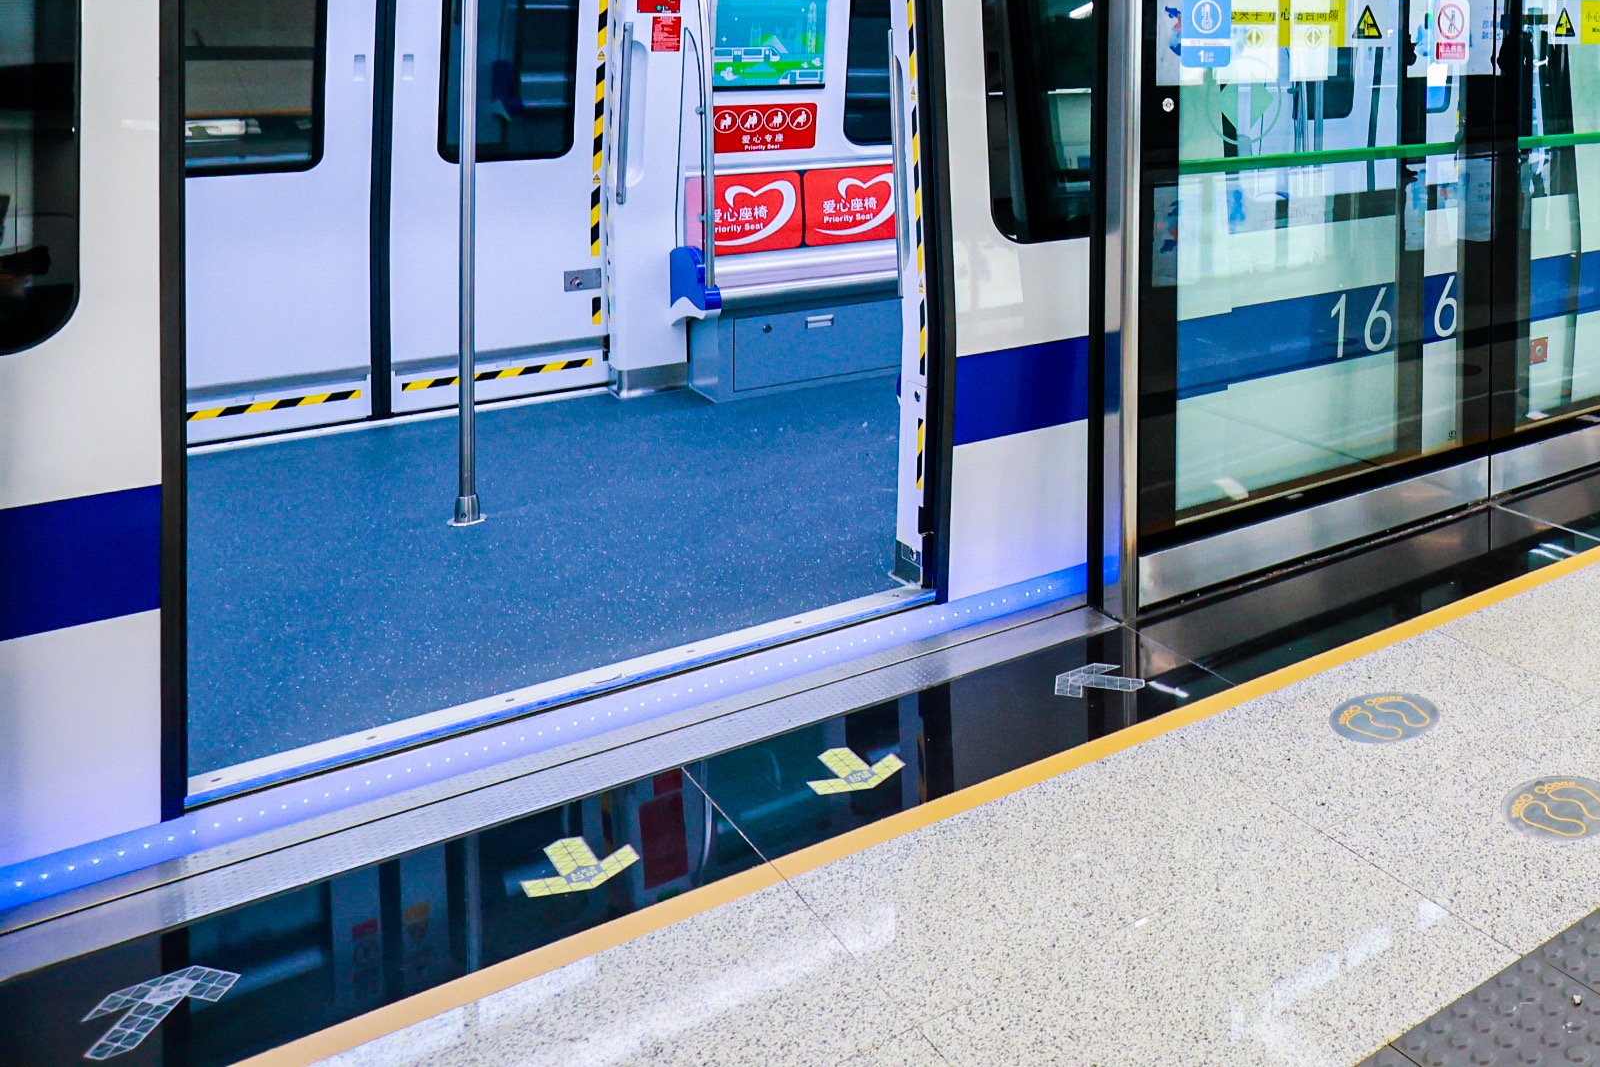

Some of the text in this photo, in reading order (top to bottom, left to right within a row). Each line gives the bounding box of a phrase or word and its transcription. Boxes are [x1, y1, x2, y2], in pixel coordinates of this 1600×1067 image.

[741, 133, 784, 144] 爱心专座
[822, 196, 877, 214] 爱心座椅
[823, 213, 874, 224] Priority Seat
[714, 222, 764, 233] riority Seat
